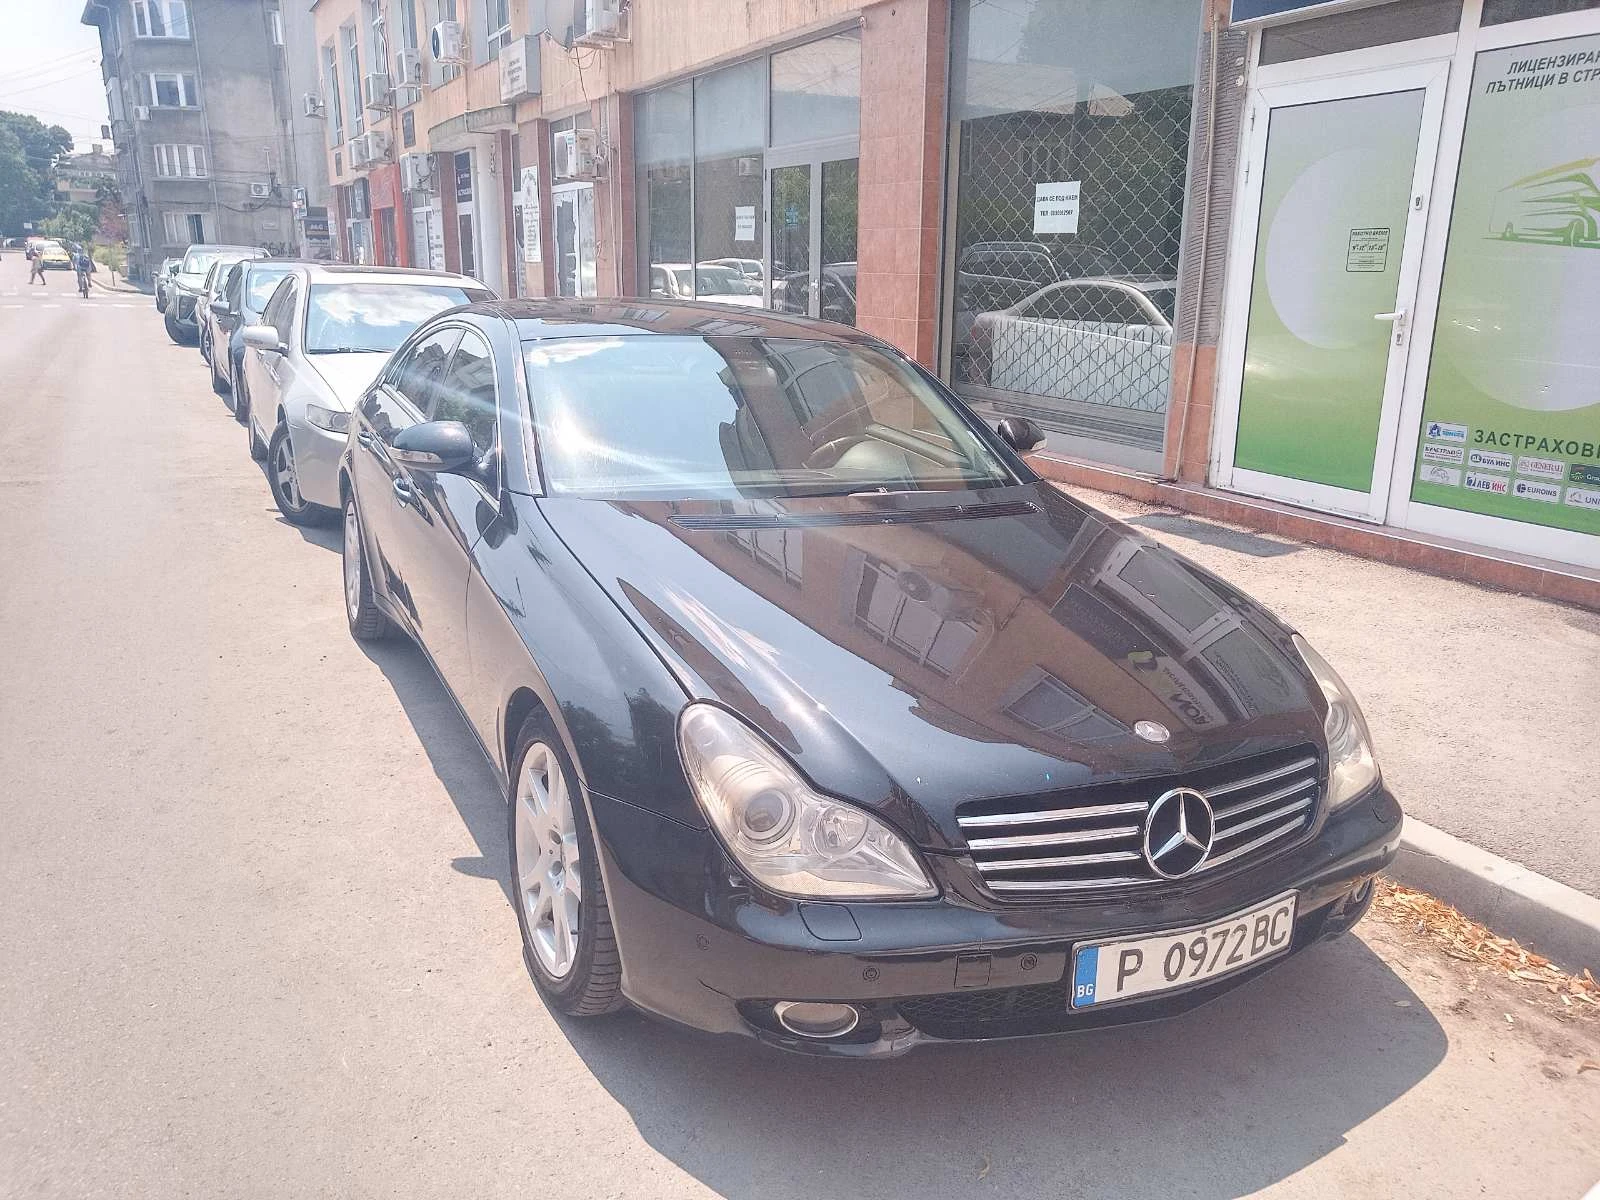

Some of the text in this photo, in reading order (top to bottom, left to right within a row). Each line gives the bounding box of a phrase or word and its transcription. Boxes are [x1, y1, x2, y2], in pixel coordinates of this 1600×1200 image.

[1486, 73, 1556, 94] ПЪТНИЦИ
[1558, 72, 1569, 85] В
[1527, 486, 1557, 497] EUROINS
[1116, 948, 1144, 993] P
[1077, 983, 1095, 998] BG
